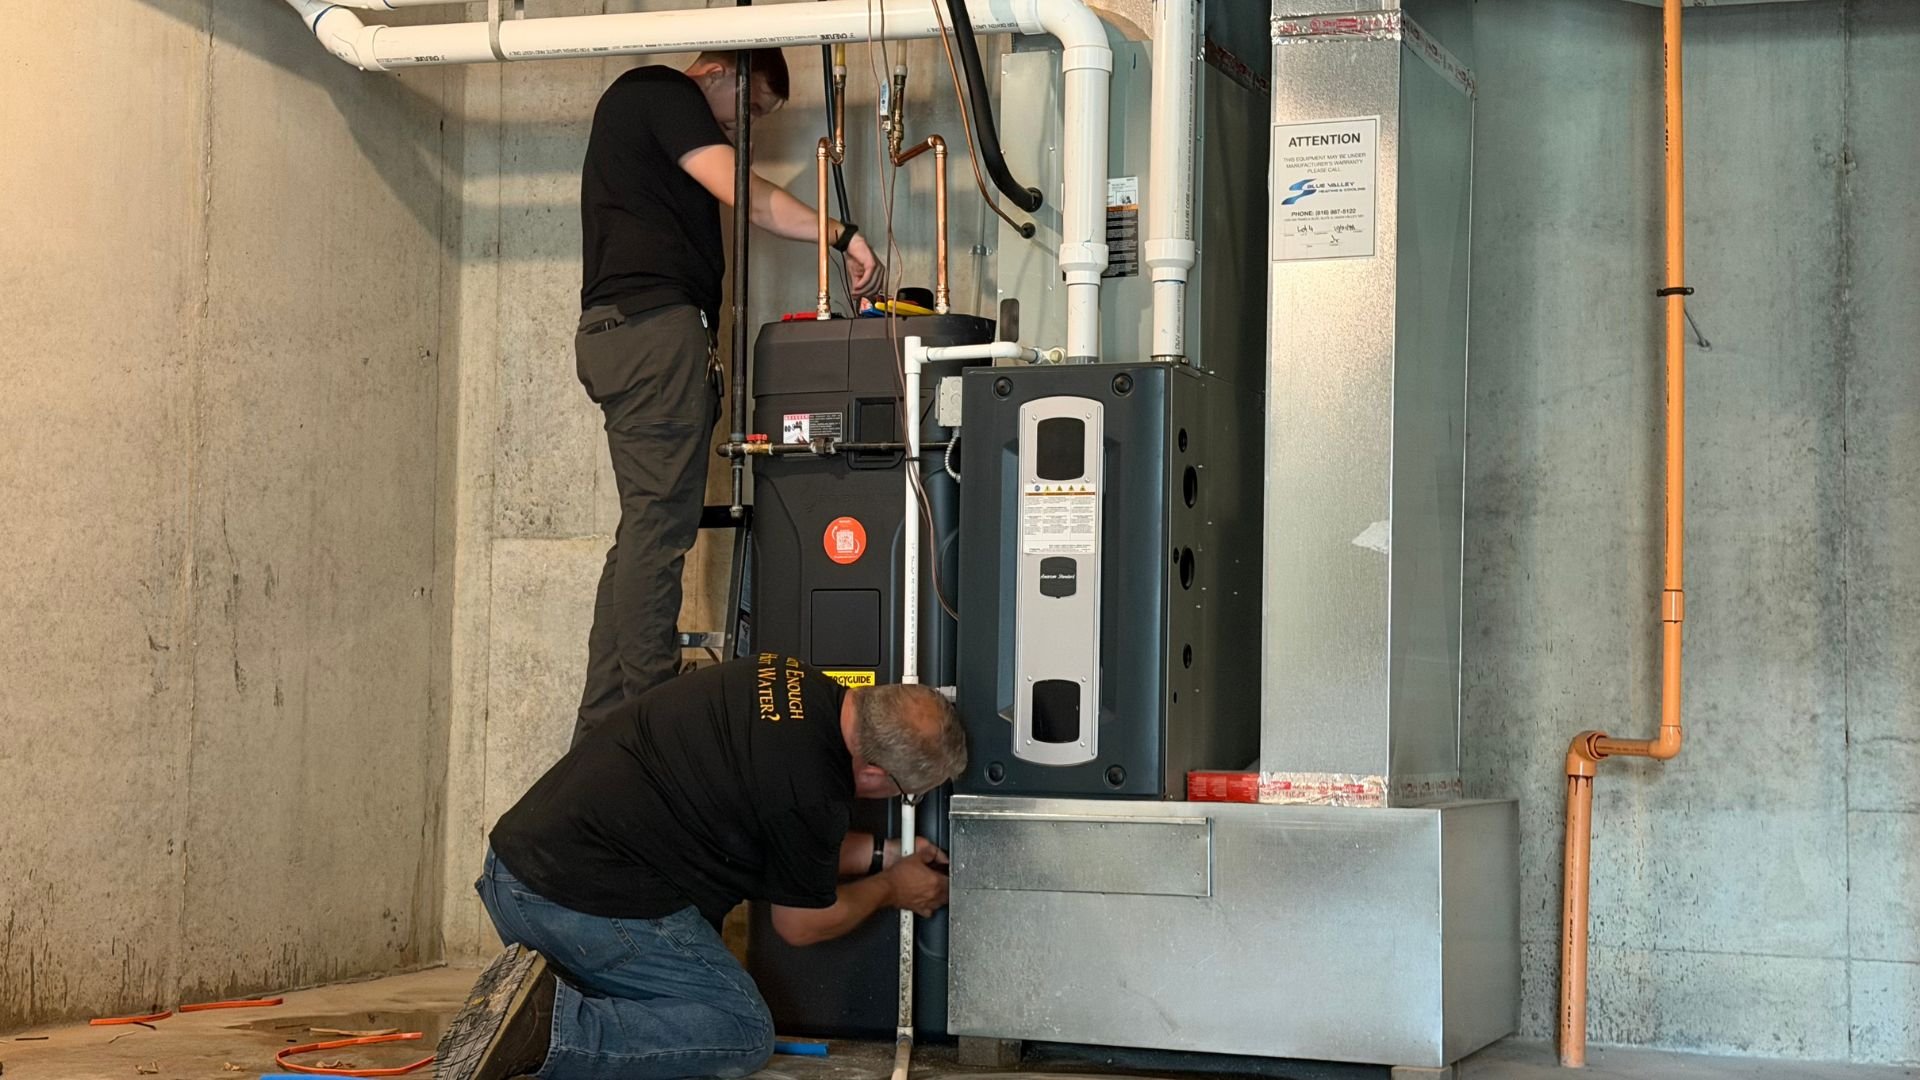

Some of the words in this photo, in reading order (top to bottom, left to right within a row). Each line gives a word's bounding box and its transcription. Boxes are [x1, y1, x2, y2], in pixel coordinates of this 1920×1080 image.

[1288, 132, 1361, 148] ATTENTION
[757, 667, 781, 721] WATER?
[785, 669, 805, 719] ENOUGH
[832, 675, 872, 685] RGYGUIDE
